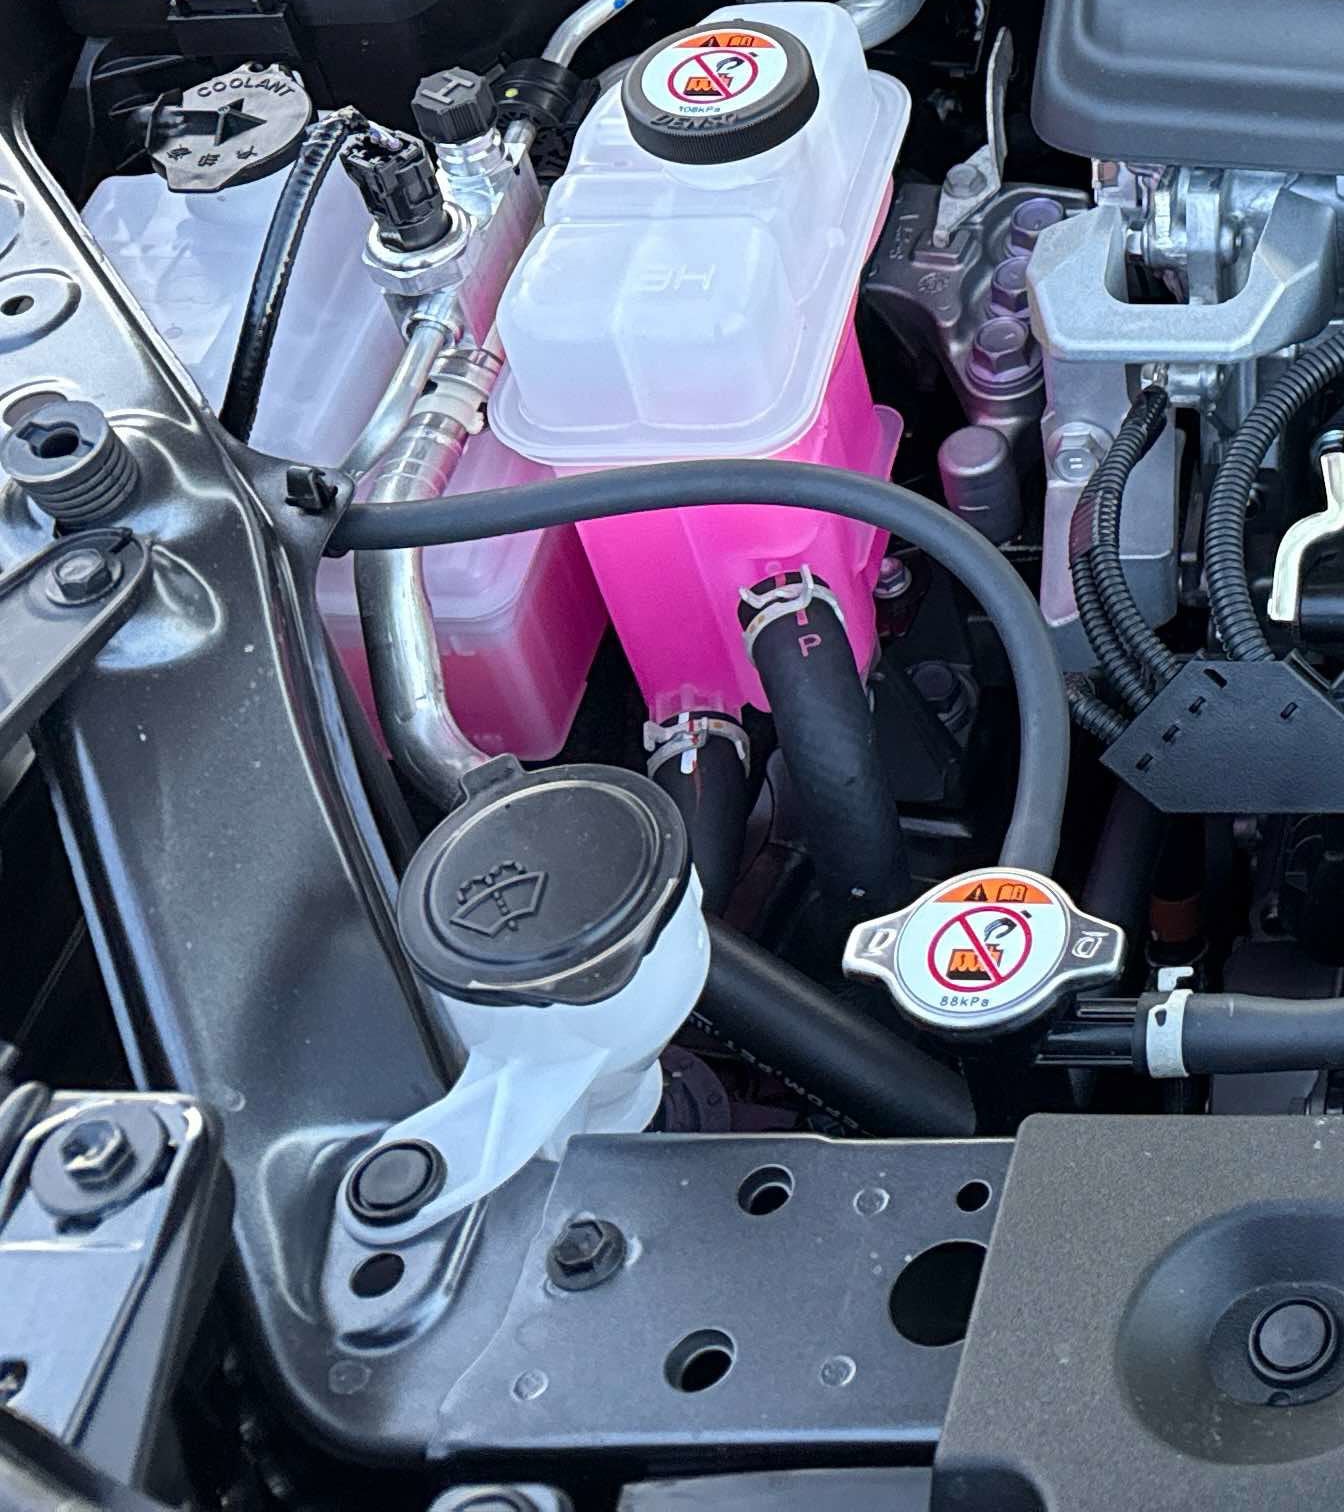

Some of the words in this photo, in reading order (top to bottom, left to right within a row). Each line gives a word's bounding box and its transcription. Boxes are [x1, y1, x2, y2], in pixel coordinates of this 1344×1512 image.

[196, 75, 296, 99] COOLANT
[798, 633, 822, 657] P
[939, 995, 991, 1008] 88kPa
